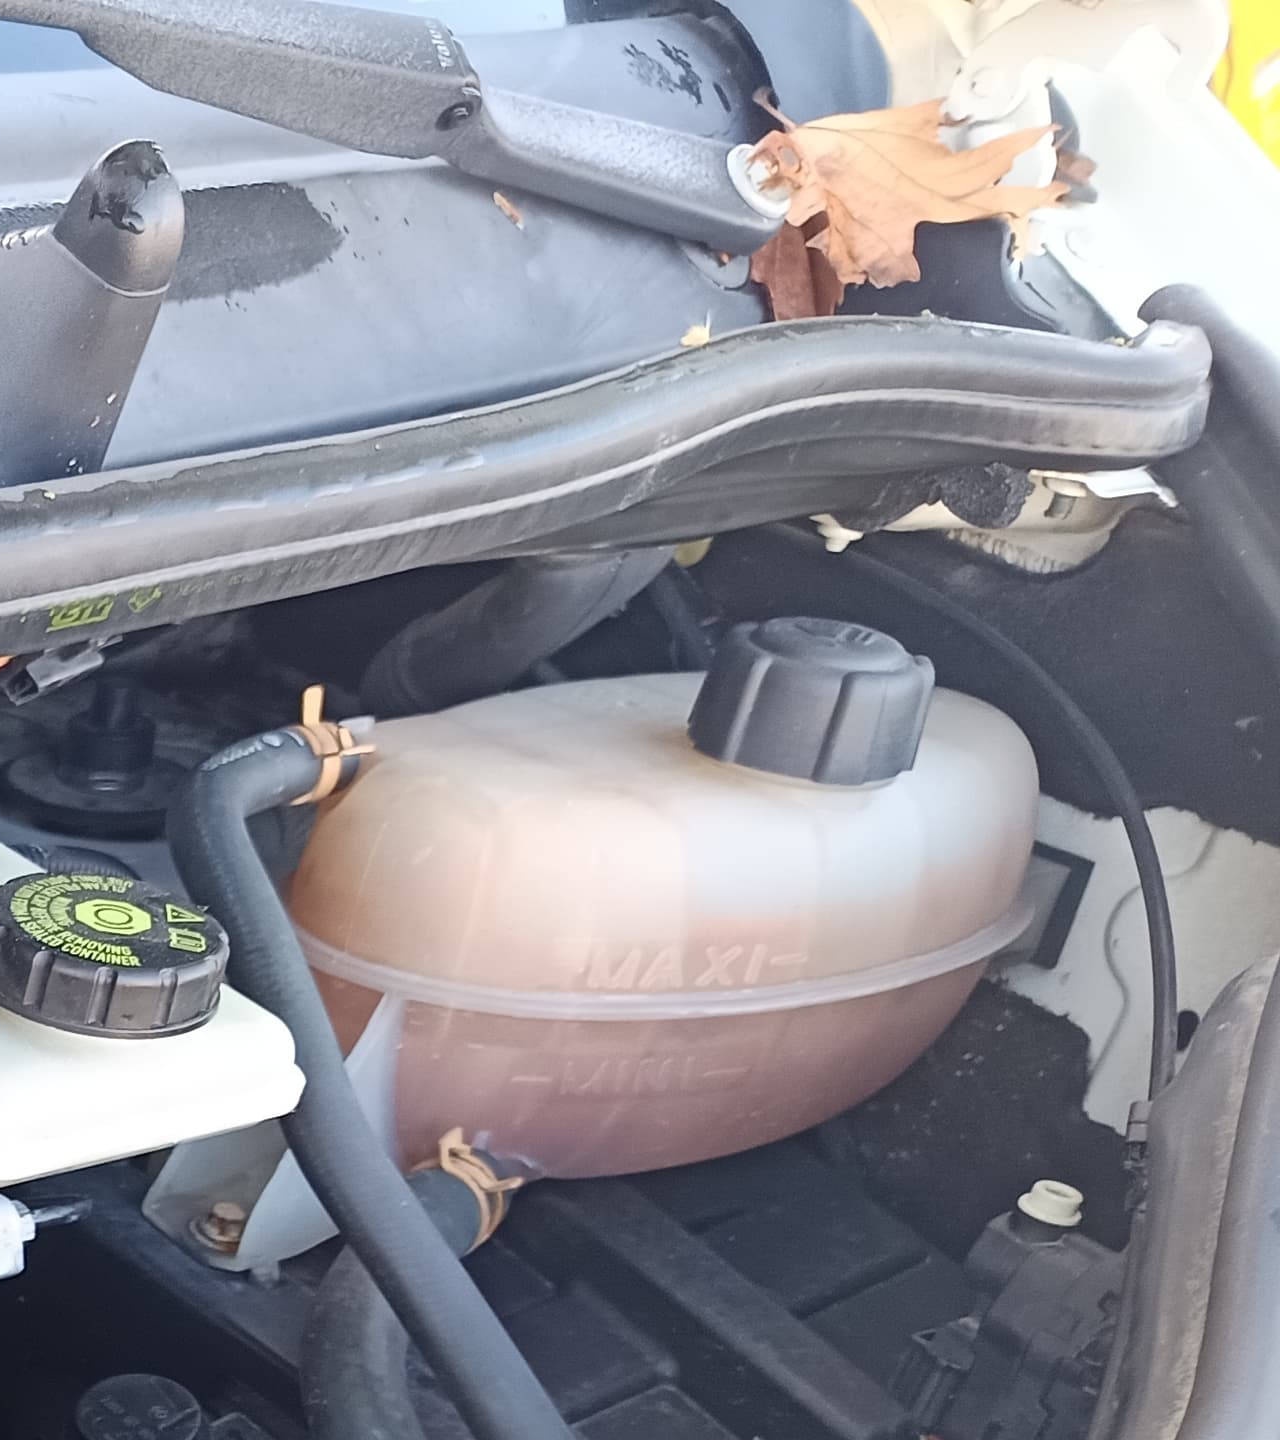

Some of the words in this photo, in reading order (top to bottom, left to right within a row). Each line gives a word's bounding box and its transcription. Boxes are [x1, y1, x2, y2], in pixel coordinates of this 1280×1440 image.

[20, 921, 64, 948] SEALED
[60, 943, 142, 967] CONTAINER
[56, 930, 133, 956] REMOVING
